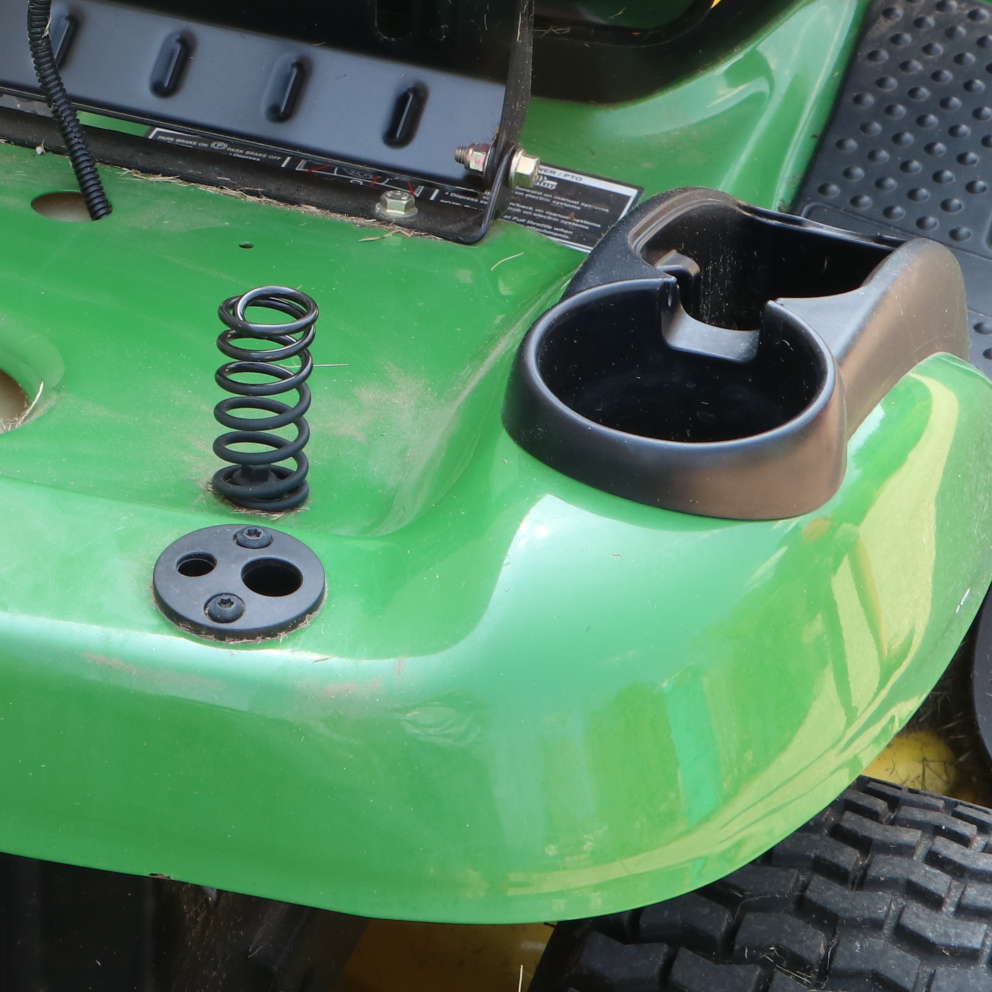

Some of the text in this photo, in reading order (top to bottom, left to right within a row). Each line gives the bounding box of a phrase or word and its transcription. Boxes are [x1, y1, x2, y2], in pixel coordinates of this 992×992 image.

[175, 138, 198, 146] BRAKE
[245, 150, 267, 158] BRAKE
[564, 173, 583, 182] PTO
